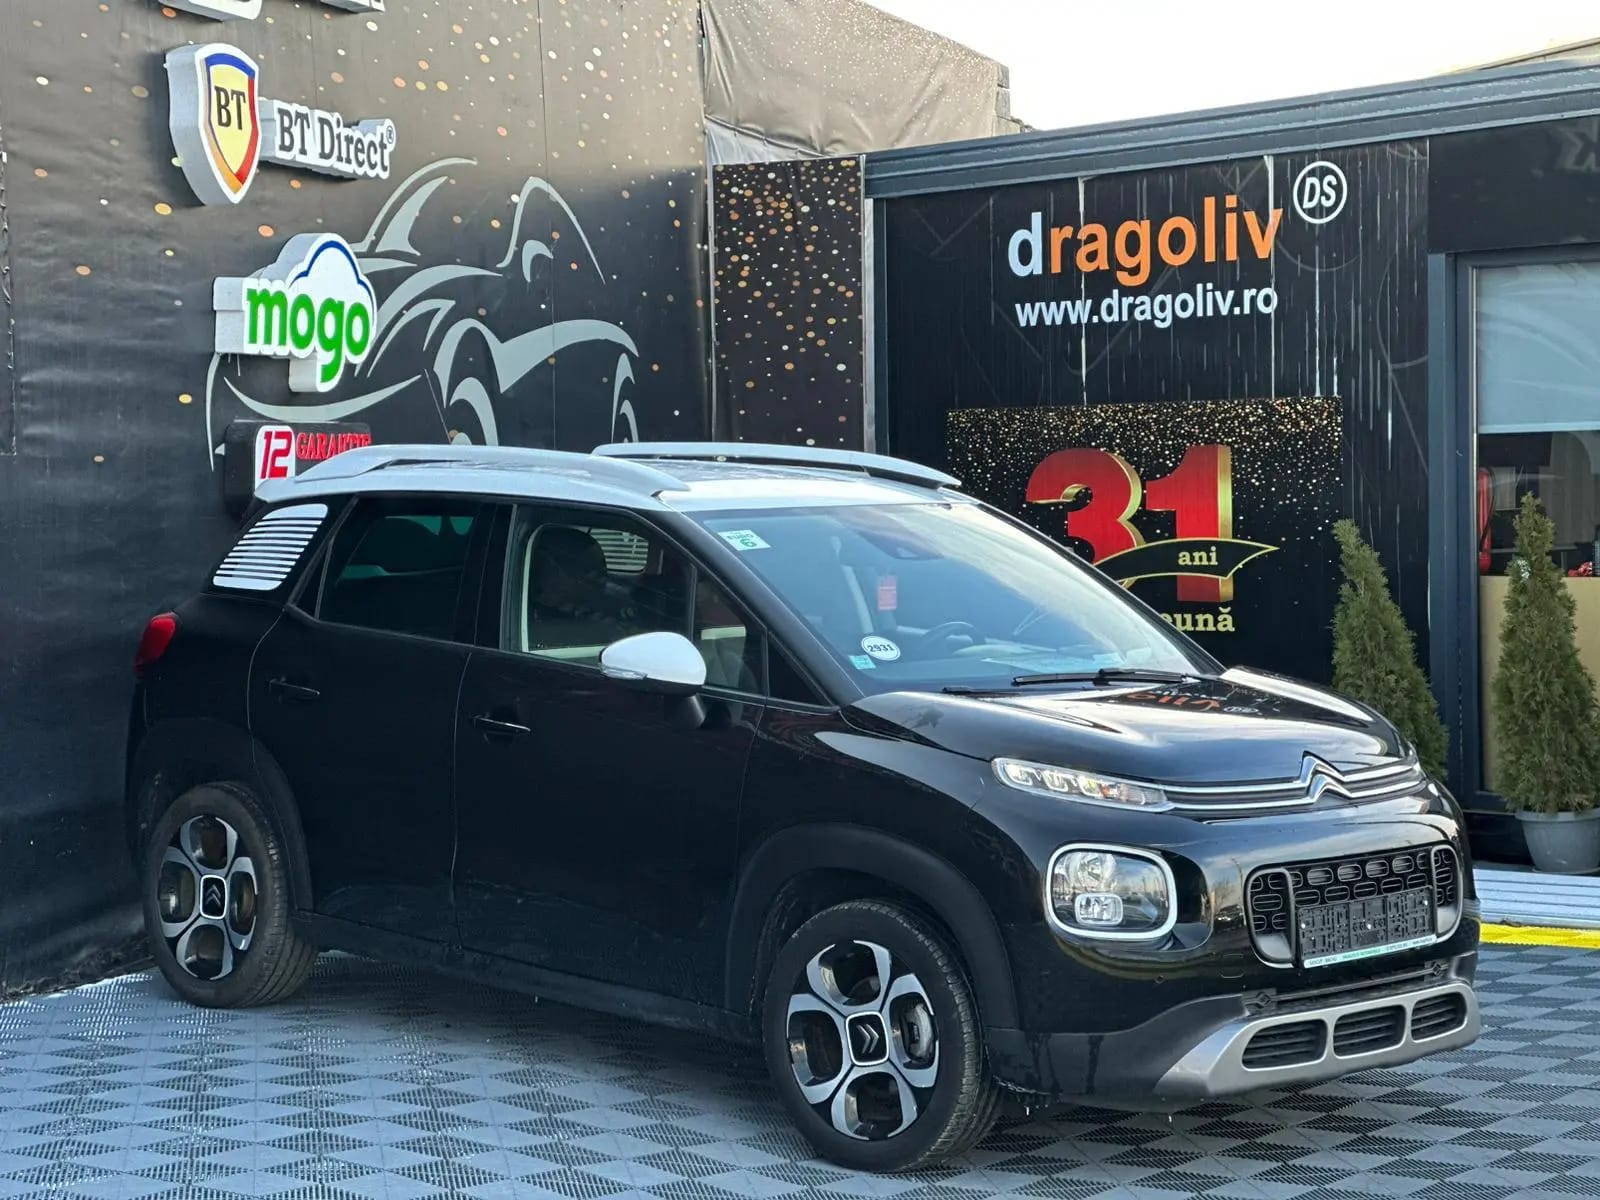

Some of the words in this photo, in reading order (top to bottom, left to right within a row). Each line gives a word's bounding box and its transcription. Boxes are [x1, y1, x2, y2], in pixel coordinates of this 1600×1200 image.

[213, 85, 246, 130] BT
[277, 107, 311, 156] BT
[1302, 174, 1338, 210] DS
[1007, 194, 1284, 287] dragoliv
[1014, 282, 1279, 329] www.dragoliv.ro
[246, 287, 371, 383] mogo
[260, 430, 293, 480] 12
[1025, 444, 1234, 603] 31
[1177, 545, 1219, 567] ani
[866, 643, 896, 653] 2931
